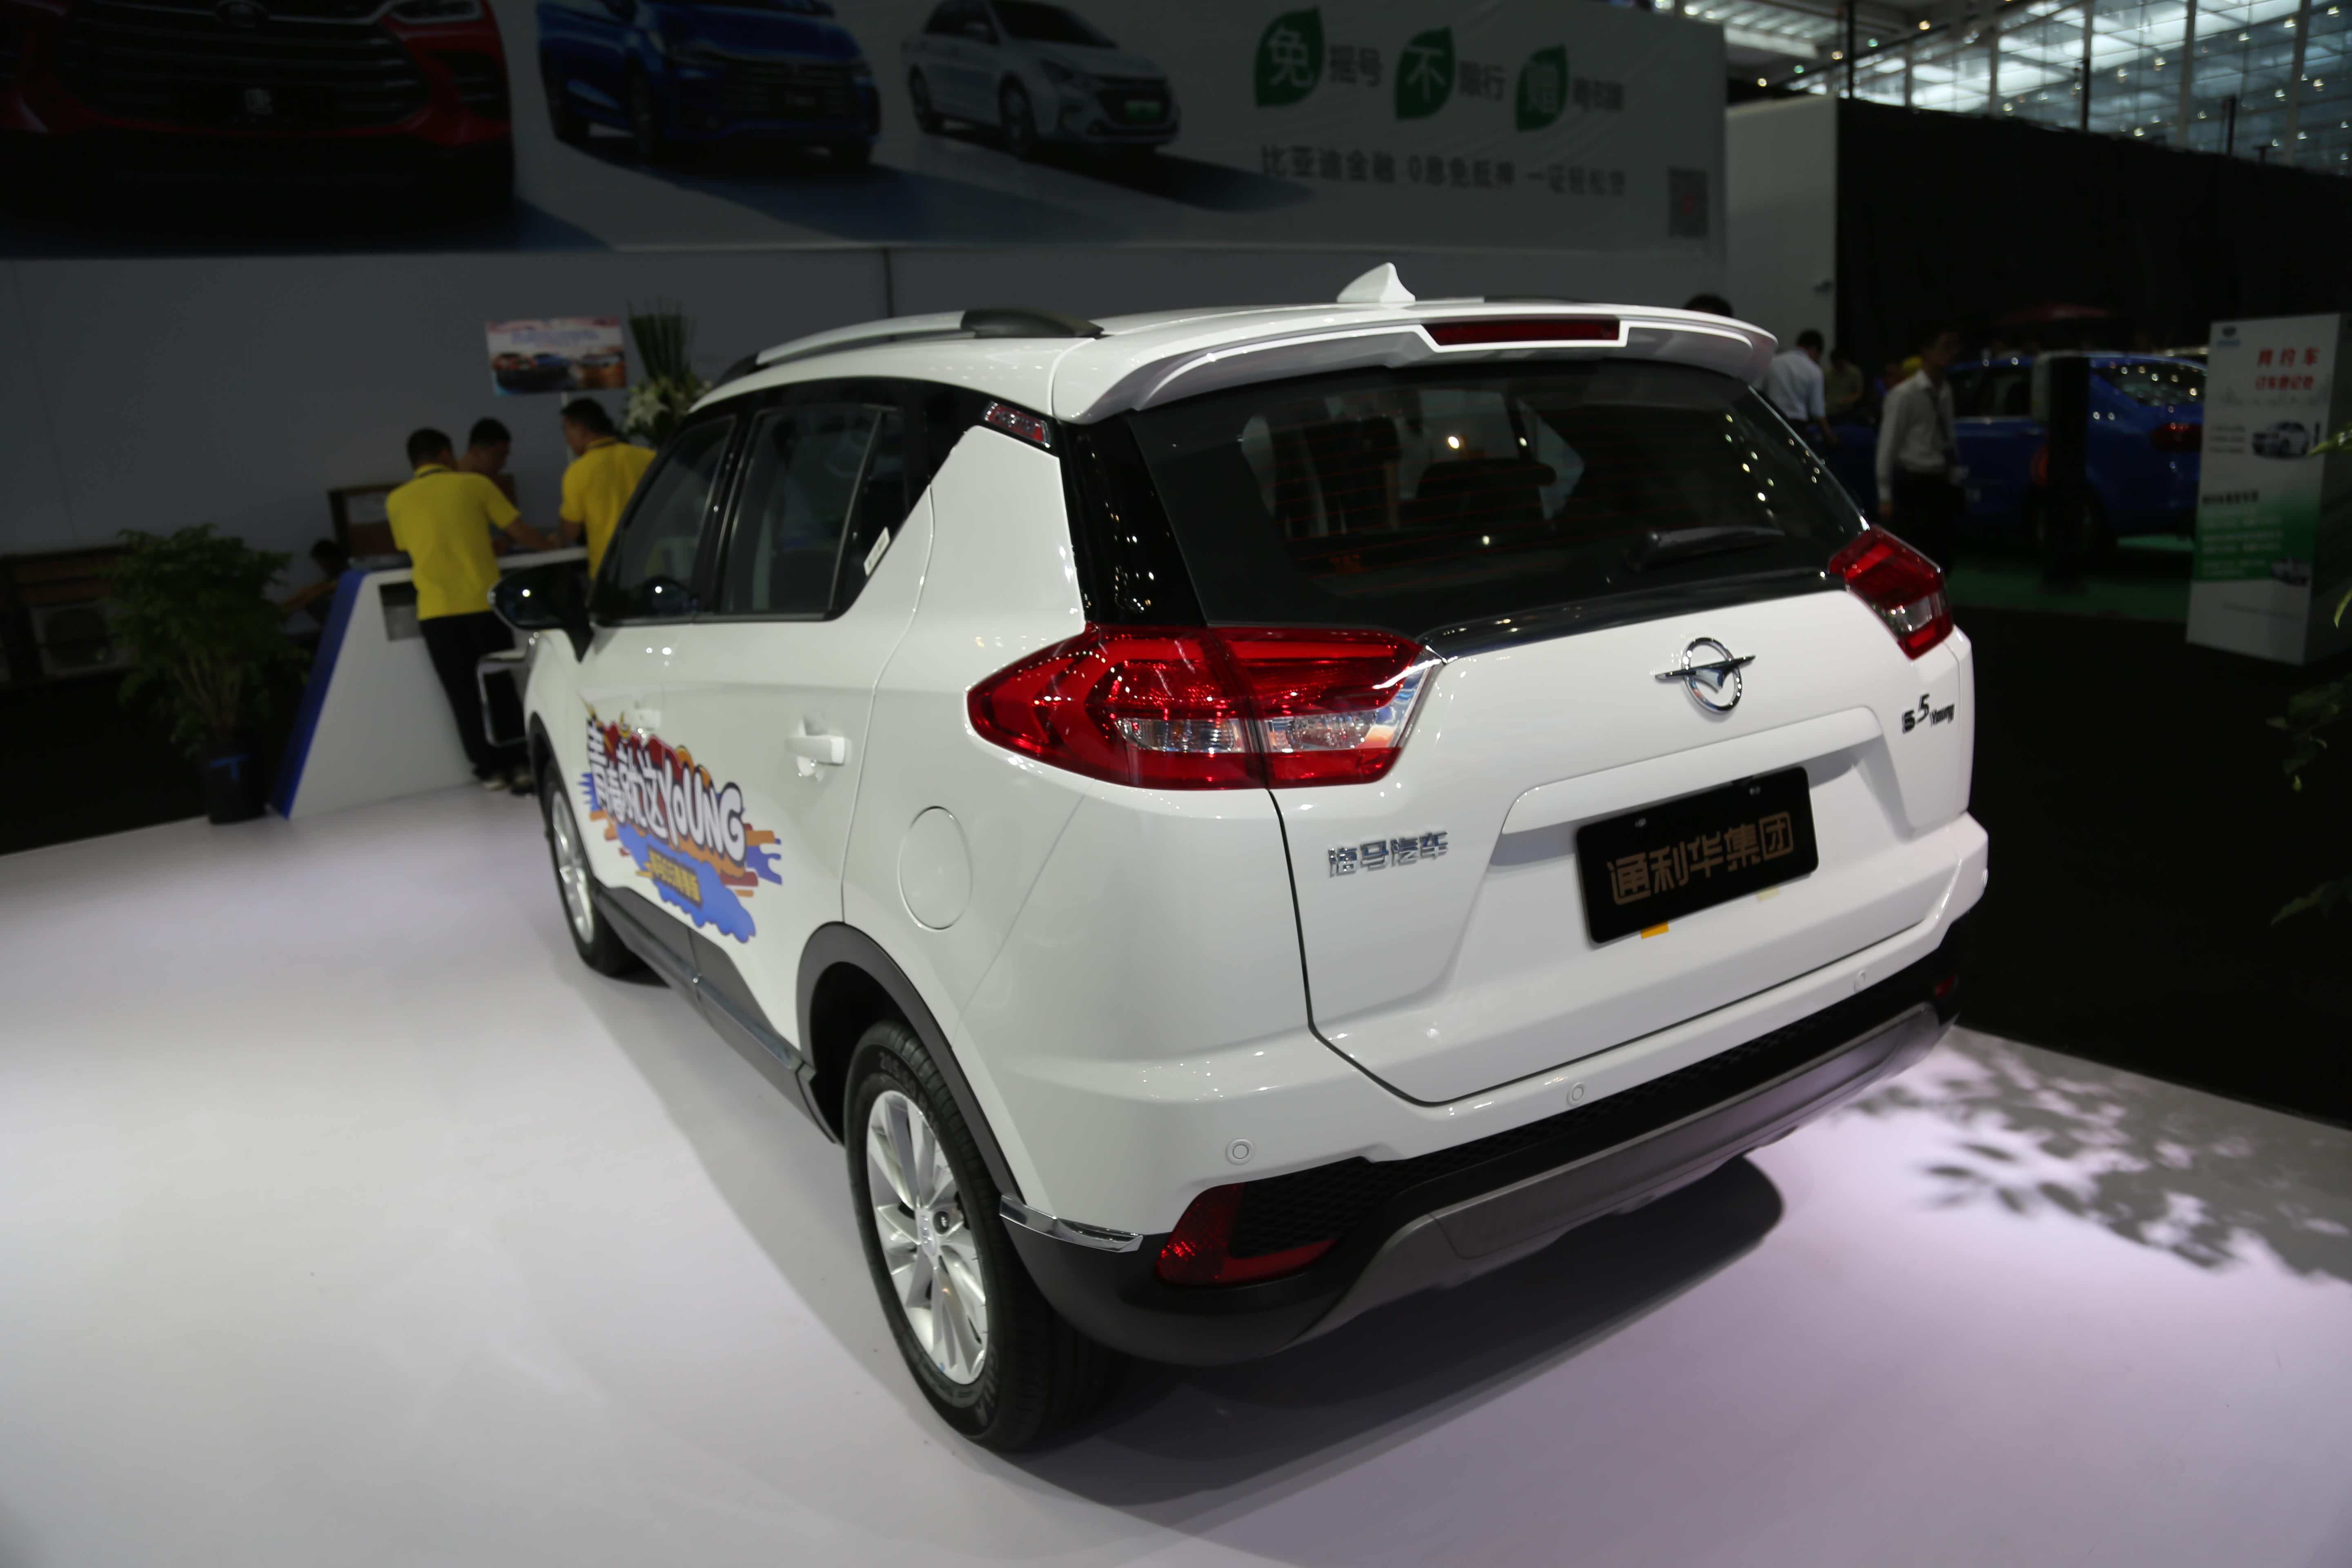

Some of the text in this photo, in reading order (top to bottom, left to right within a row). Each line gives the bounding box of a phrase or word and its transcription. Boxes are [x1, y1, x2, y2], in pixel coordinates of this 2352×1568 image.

[1328, 831, 1448, 878] 海马汽车
[1607, 811, 1794, 905] 通利华集团
